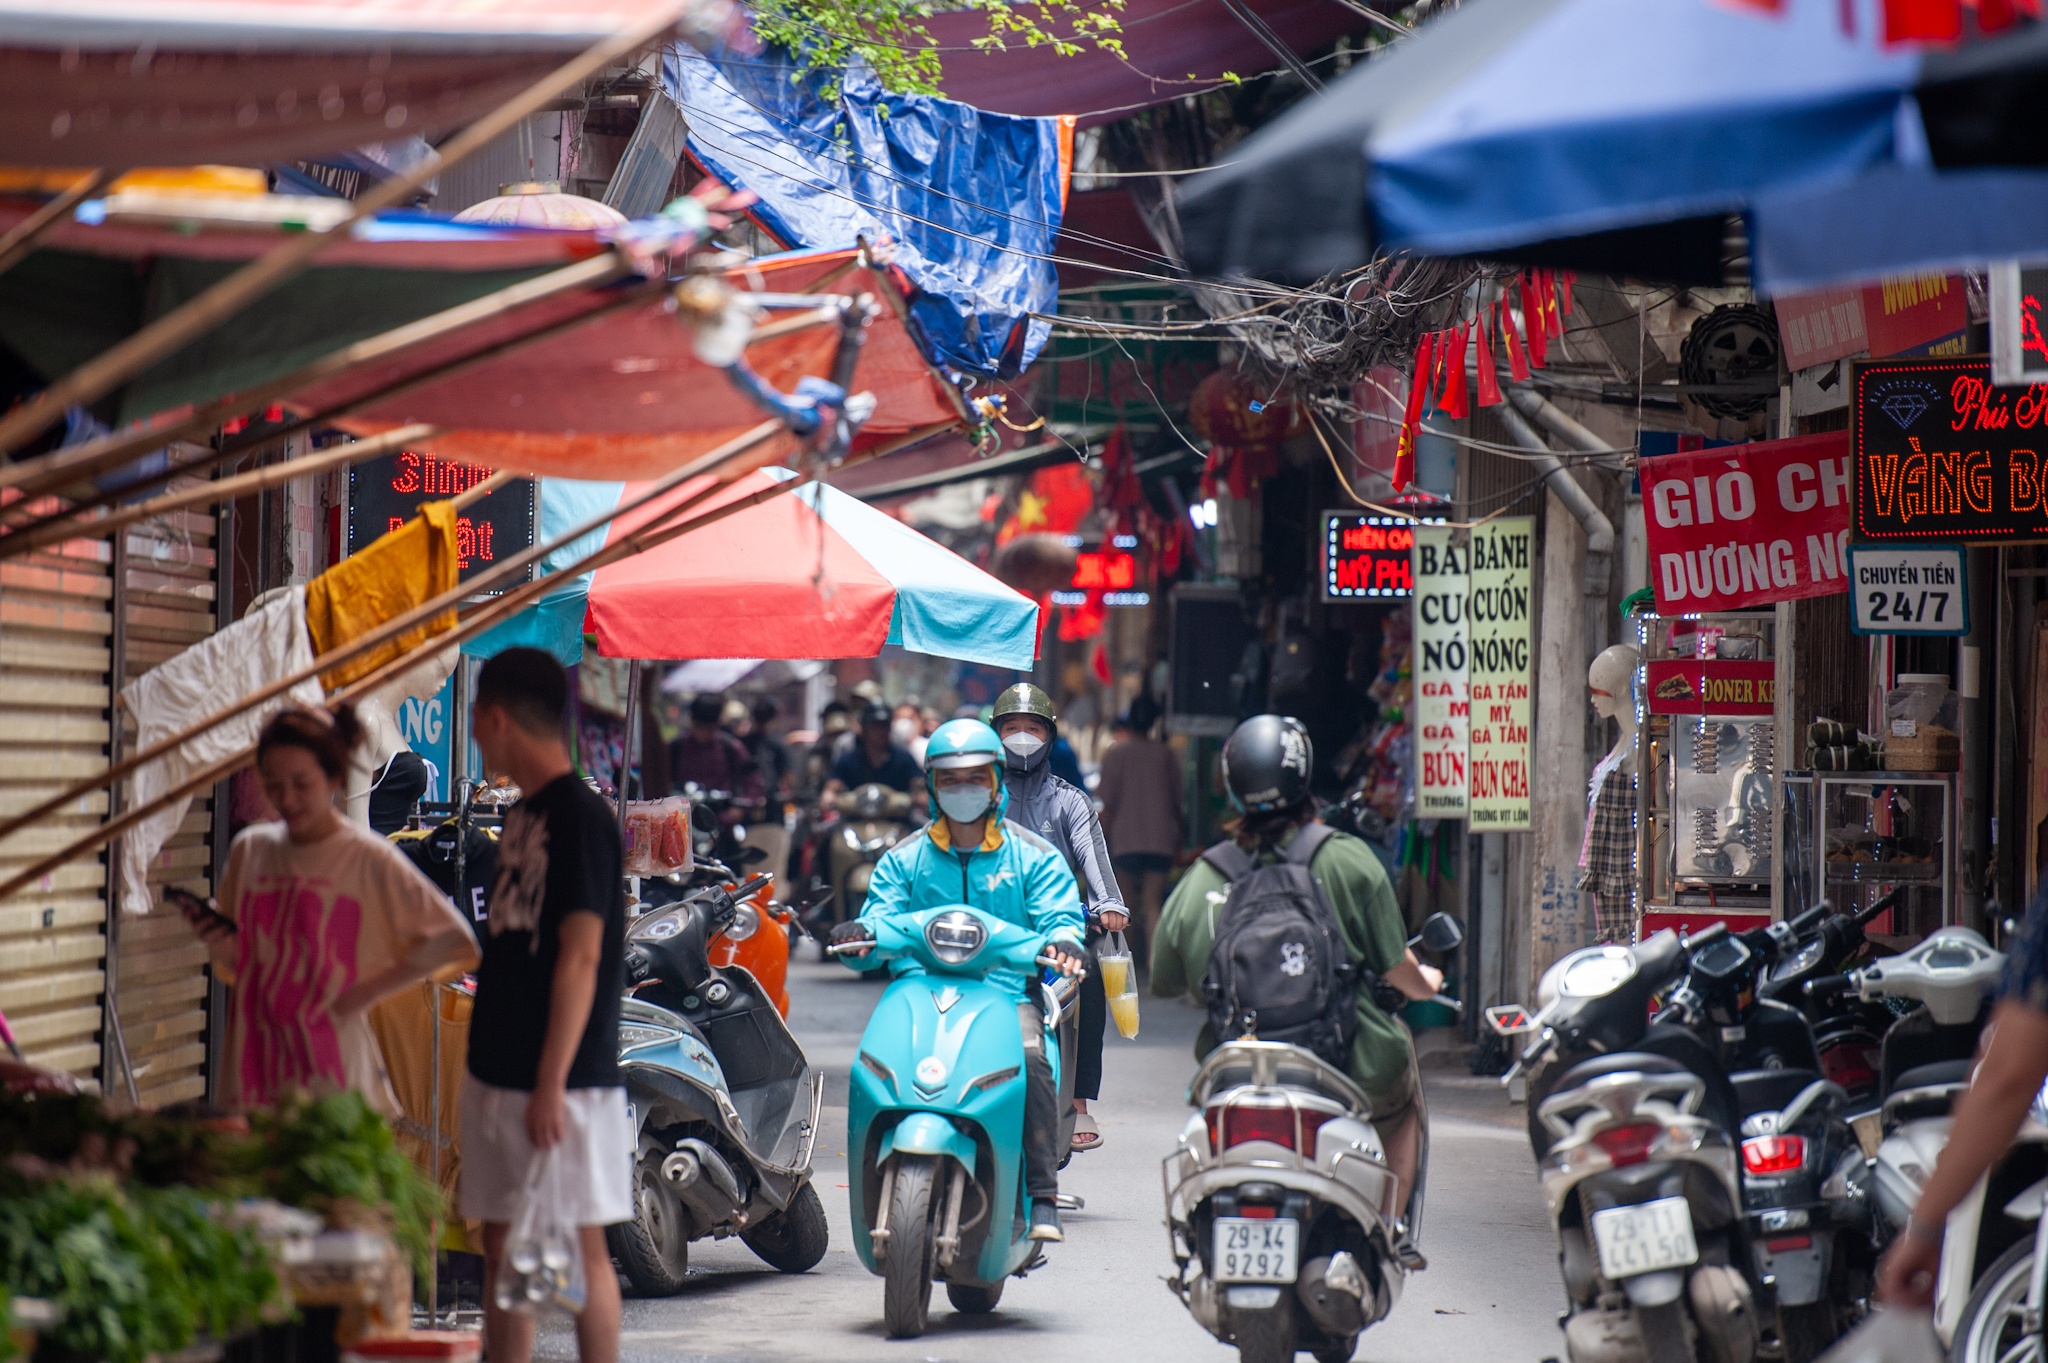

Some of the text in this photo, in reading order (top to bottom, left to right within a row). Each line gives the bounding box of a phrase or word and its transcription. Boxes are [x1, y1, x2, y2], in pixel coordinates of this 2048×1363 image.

[1653, 460, 1756, 528] GIÒ
[1869, 437, 2048, 523] VÀNG B
[1420, 535, 1469, 575] BÁ
[1474, 526, 1528, 570] BÁNH
[1376, 559, 1414, 589] PH
[1660, 541, 1797, 601] DƯƠNG
[1860, 560, 1955, 585] CHUYỂN TIỀN
[1421, 594, 1469, 624] CU
[1474, 573, 1528, 622] CUỐN
[1868, 591, 1949, 622] 24/7
[1473, 629, 1528, 673] NÓNG
[1473, 681, 1492, 700] GÀ
[1704, 679, 1753, 703] DONER
[1472, 725, 1491, 743] GÀ
[1423, 742, 1465, 787] BÚN
[1472, 747, 1529, 799] BÚN CHẢ
[1226, 1253, 1284, 1276] 9292
